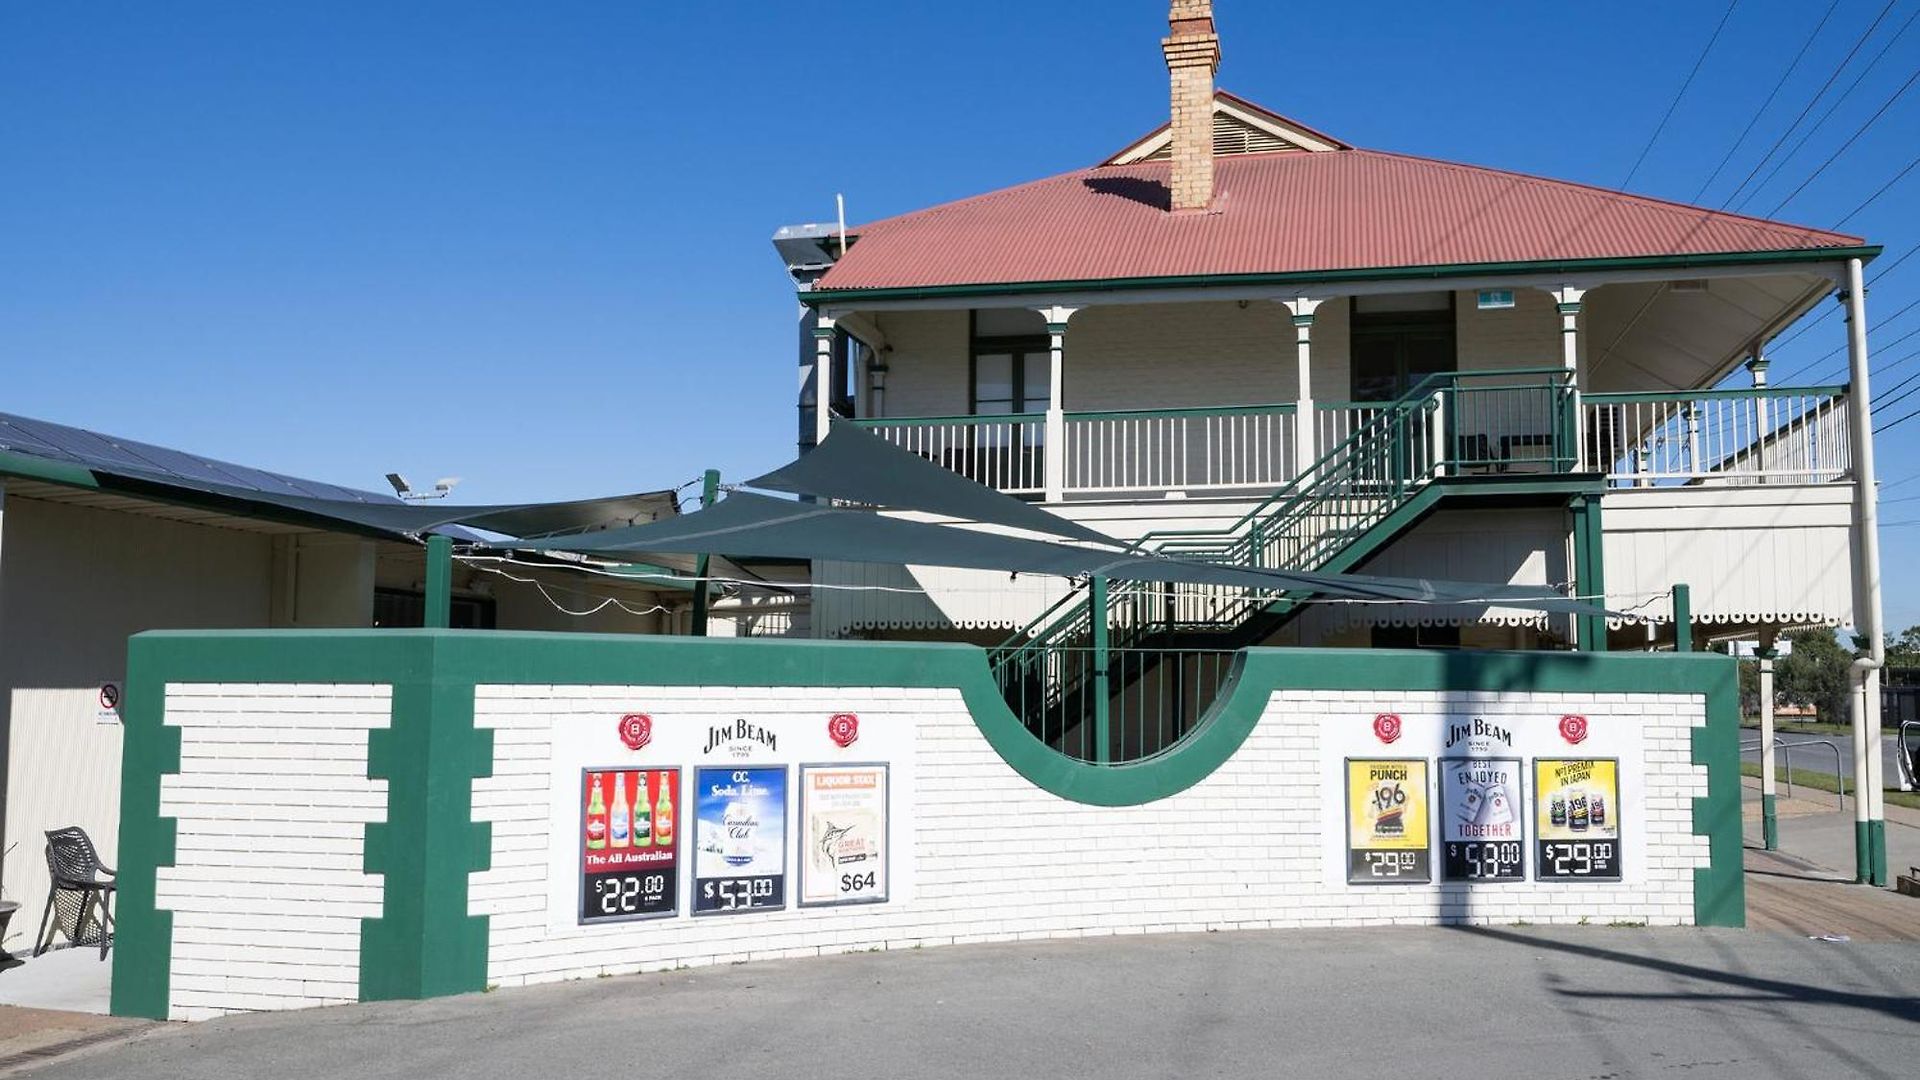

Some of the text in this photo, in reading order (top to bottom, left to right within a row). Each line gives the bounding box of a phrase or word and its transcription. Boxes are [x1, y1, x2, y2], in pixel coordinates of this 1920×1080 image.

[703, 718, 777, 754] JIM BEAM
[1446, 718, 1512, 748] JIM BEAM
[1472, 759, 1492, 769] BEST
[1370, 769, 1408, 781] PUNCH
[1458, 771, 1507, 785] ENJOYED
[1560, 770, 1591, 787] IN JAPAN
[728, 826, 750, 840] Club
[1458, 824, 1512, 837] TOGETHER
[587, 851, 673, 865] The All Australian
[841, 871, 876, 893] $64
